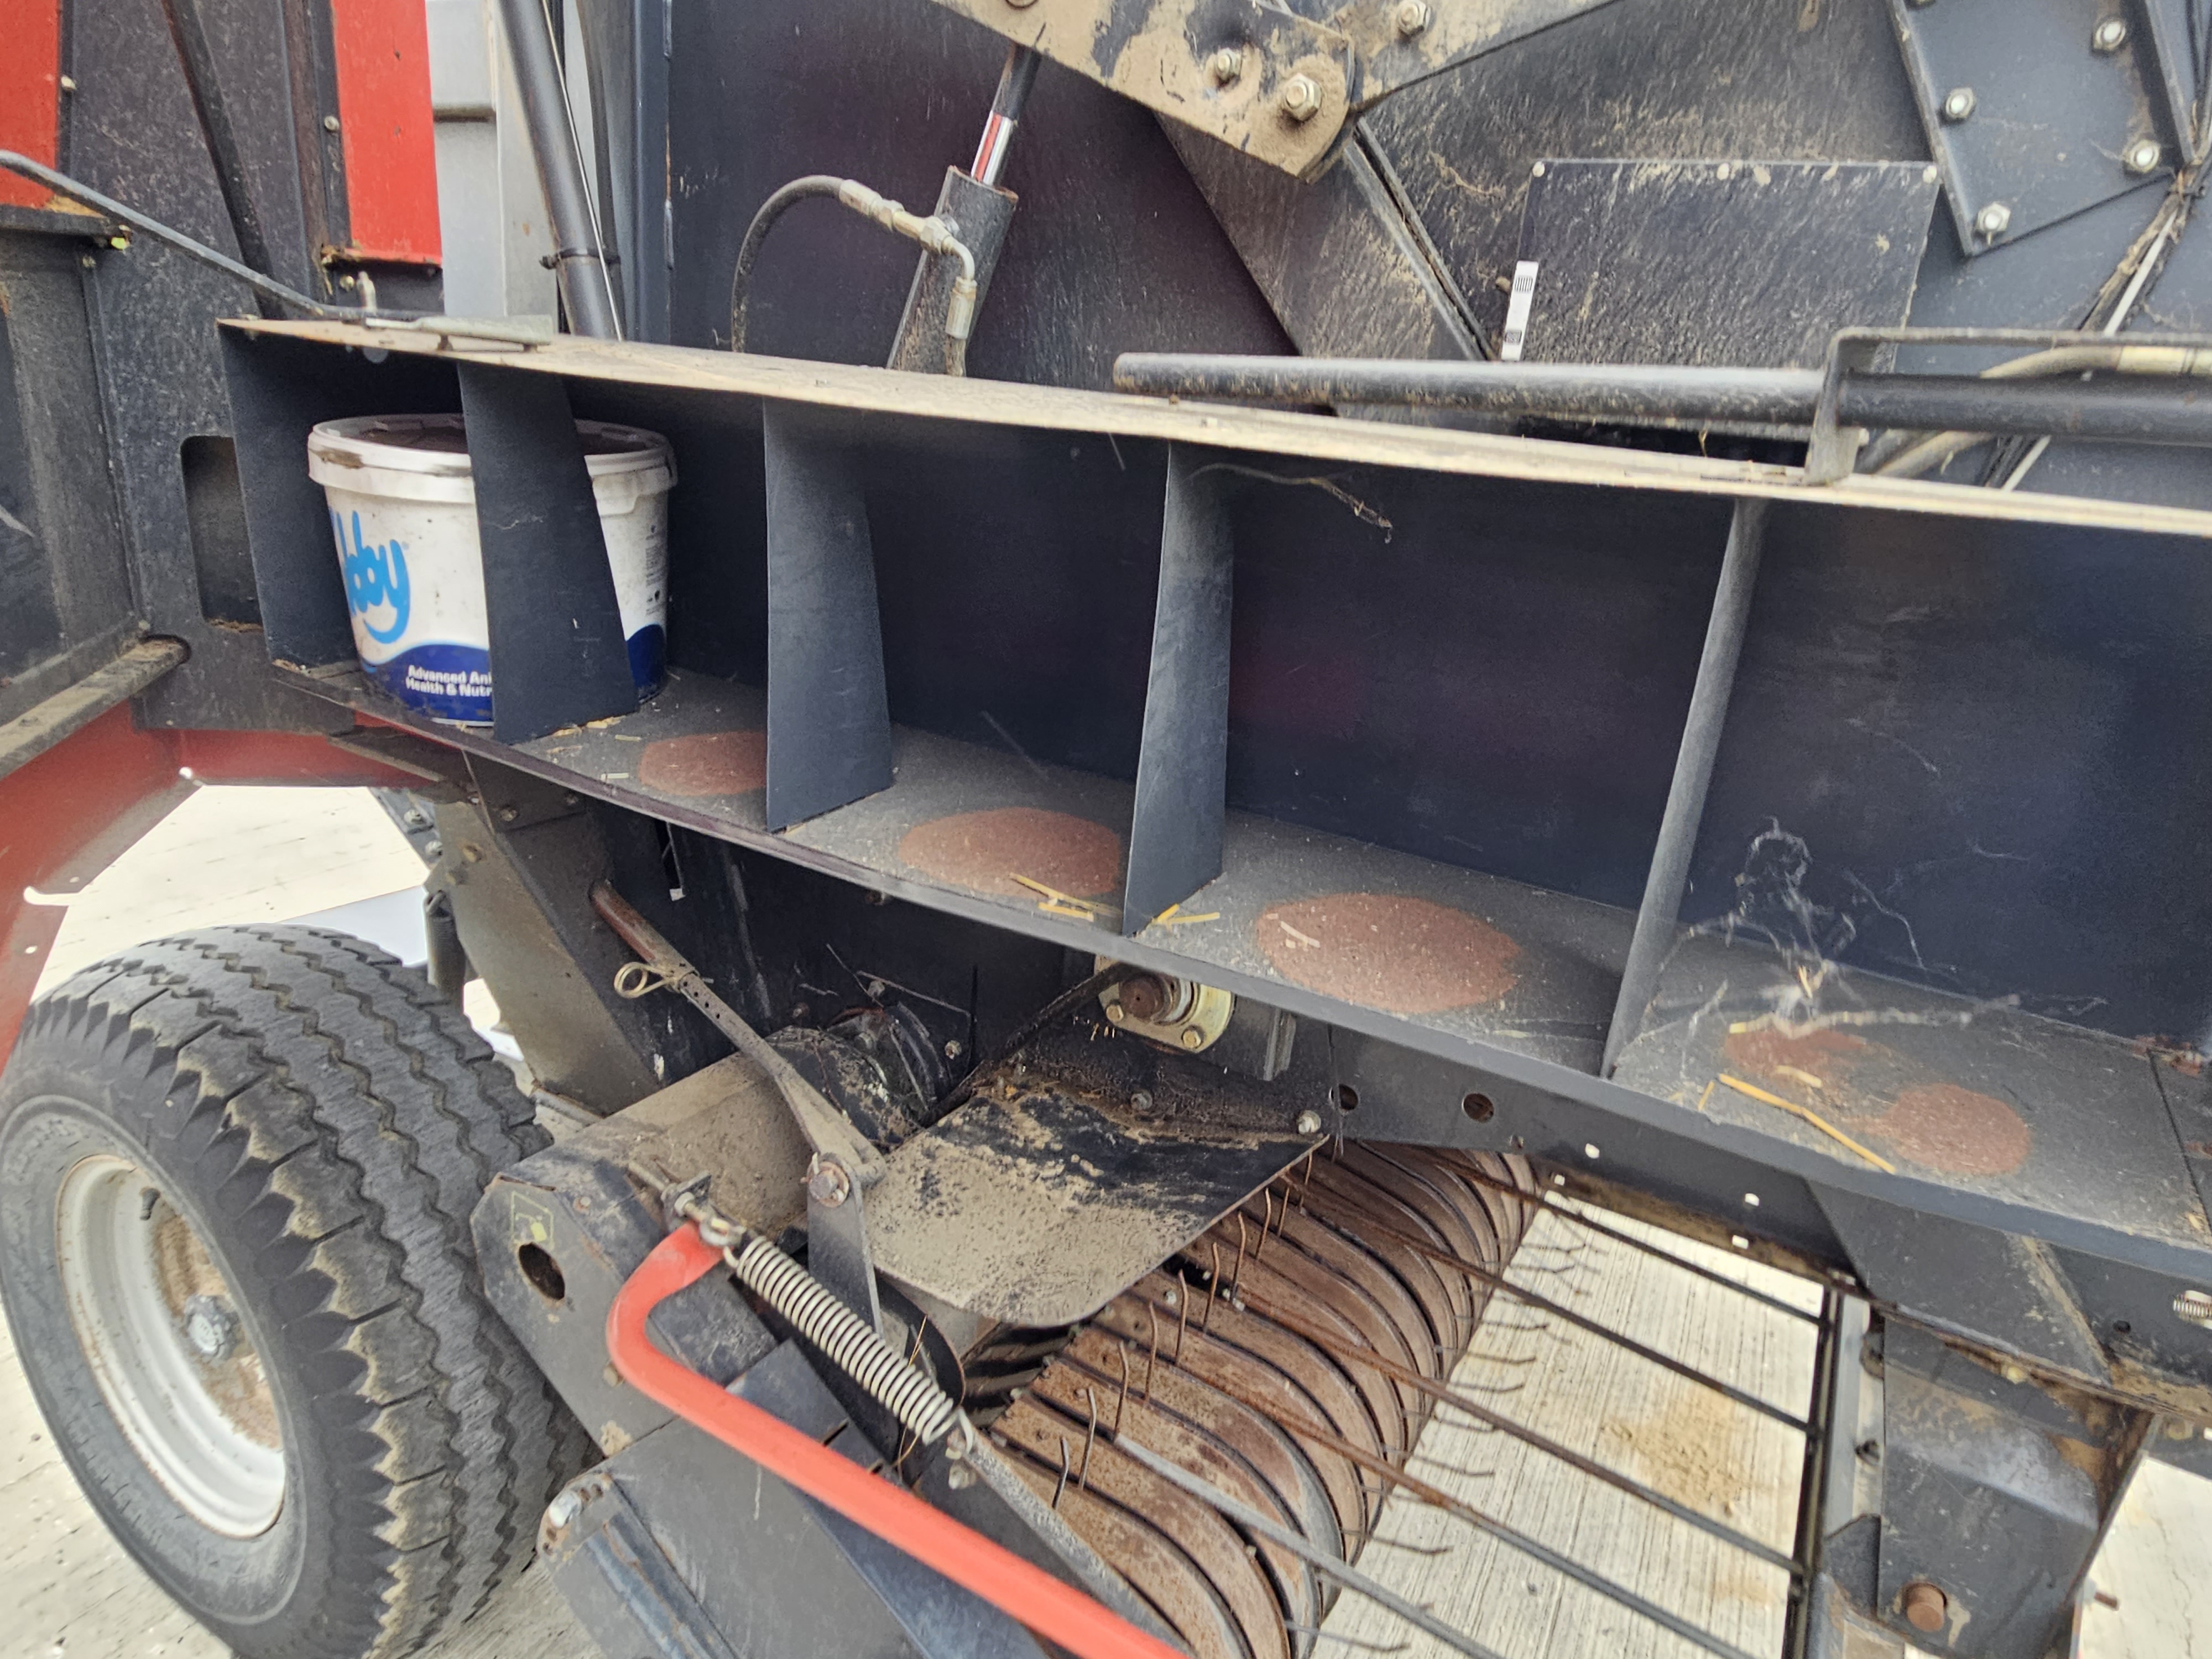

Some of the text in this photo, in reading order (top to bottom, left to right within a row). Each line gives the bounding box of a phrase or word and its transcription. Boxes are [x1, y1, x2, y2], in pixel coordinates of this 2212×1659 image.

[408, 665, 467, 684] Advanced
[405, 676, 444, 695] Health
[446, 683, 457, 696] &
